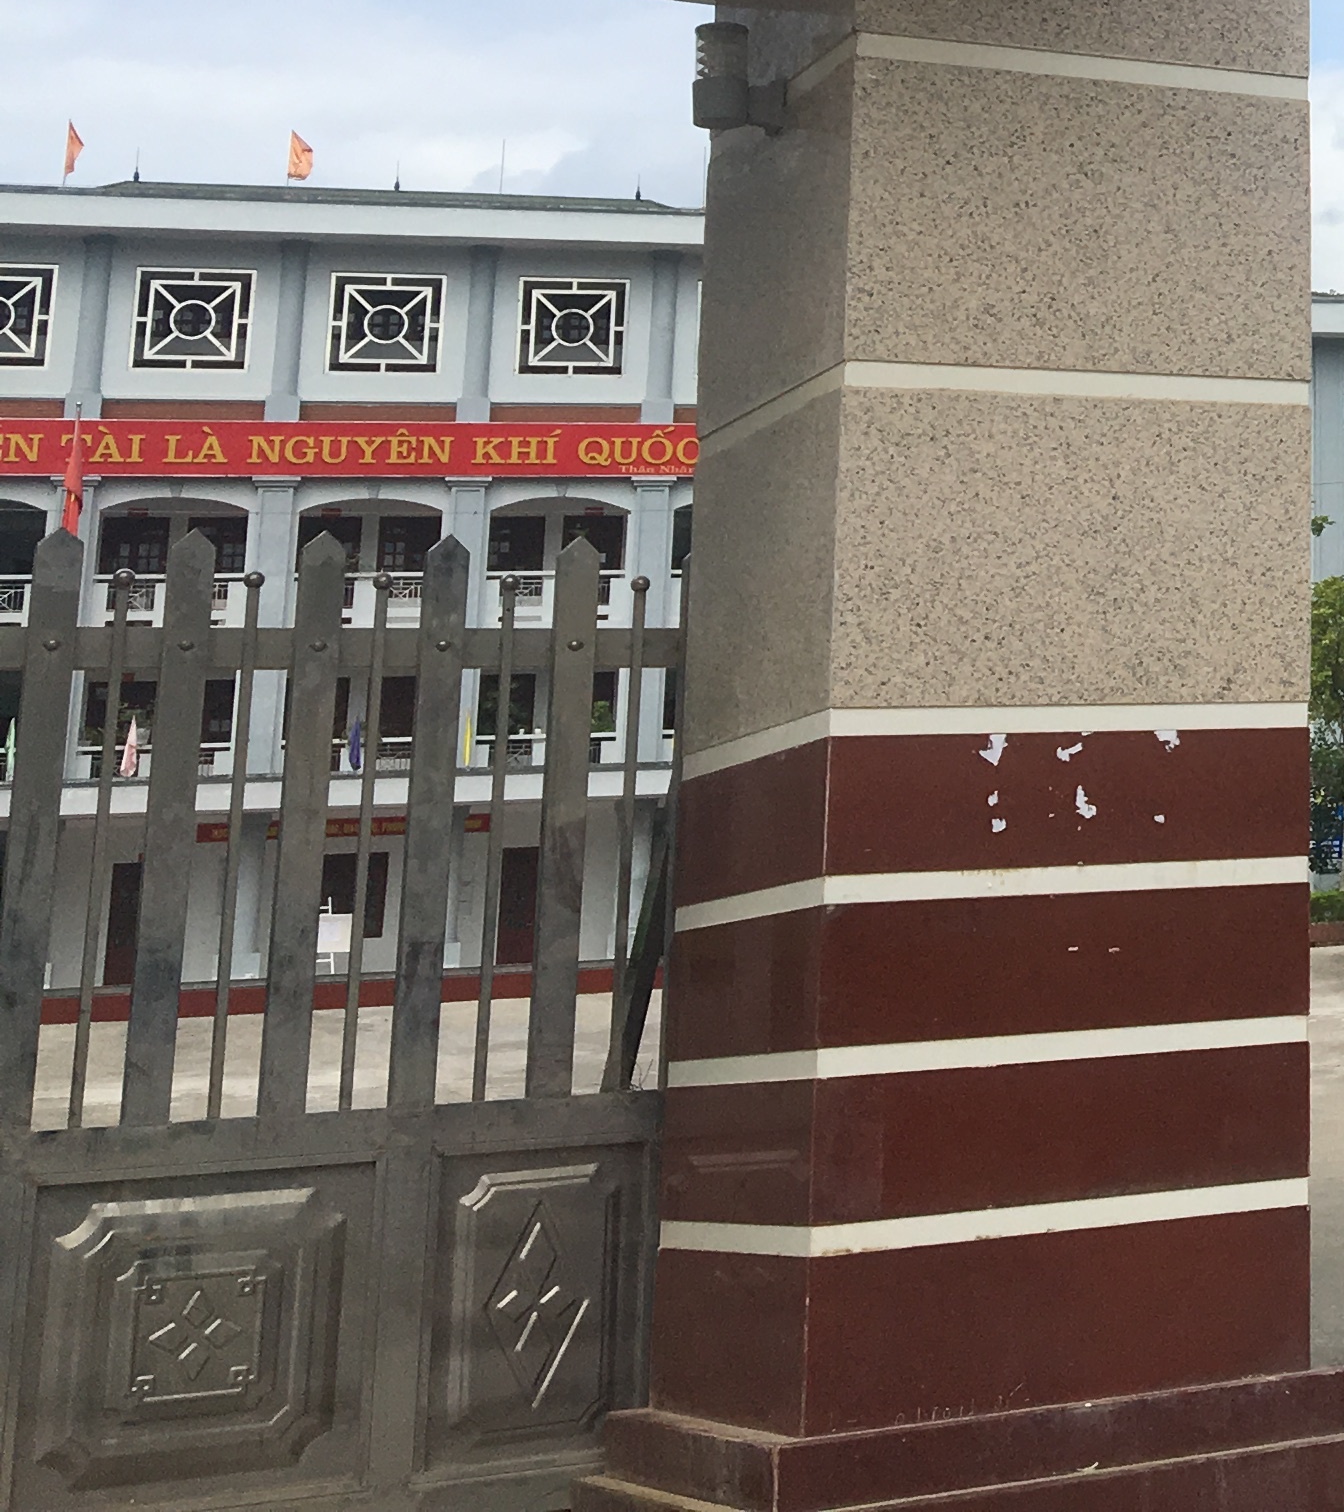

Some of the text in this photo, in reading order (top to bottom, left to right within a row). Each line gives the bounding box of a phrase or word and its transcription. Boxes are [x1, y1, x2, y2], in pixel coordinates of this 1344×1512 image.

[162, 426, 228, 463] LÀ
[246, 427, 455, 465] NGUYÊN
[471, 428, 562, 465] KHÍ
